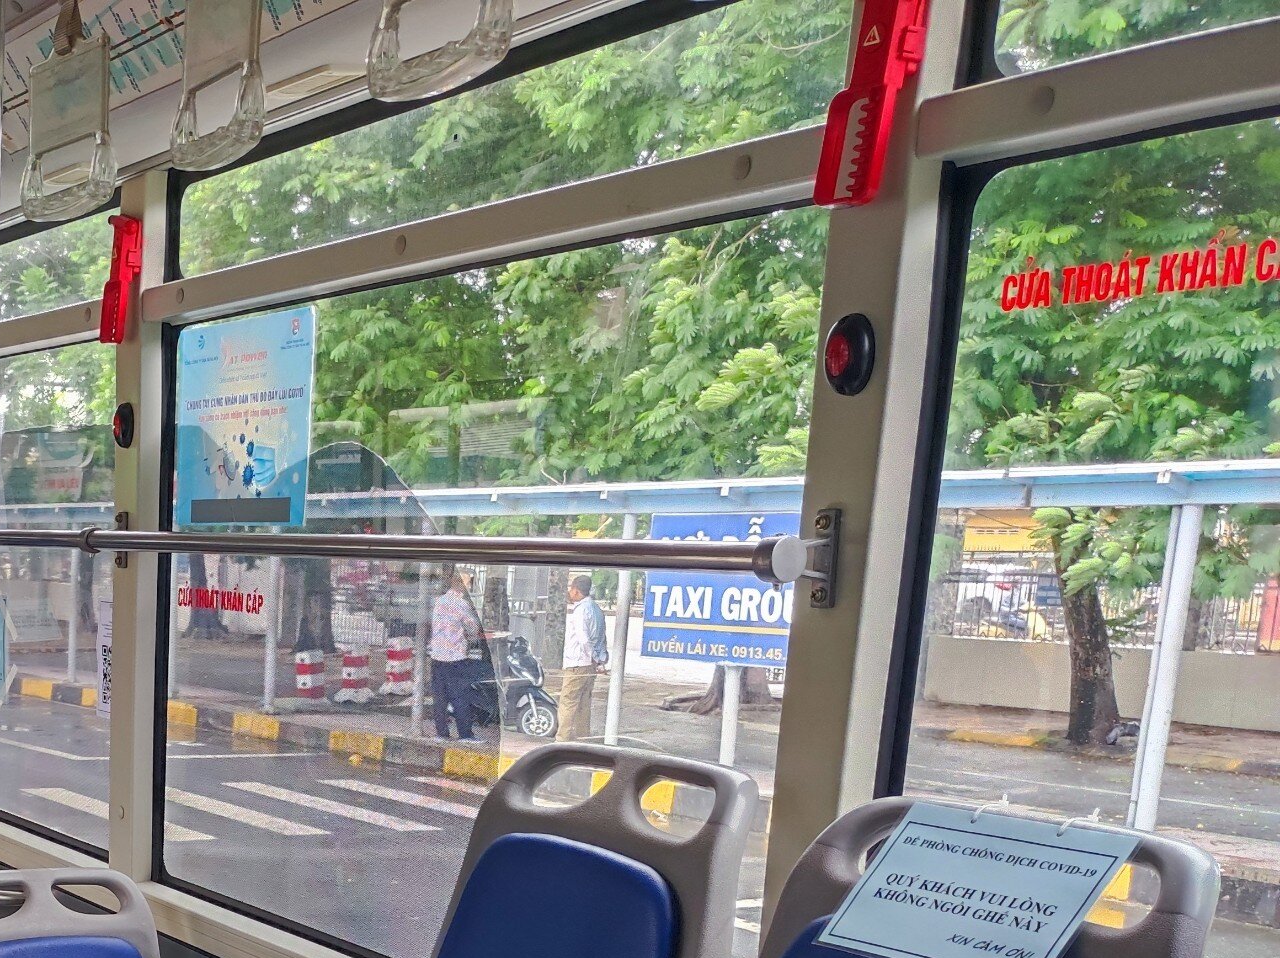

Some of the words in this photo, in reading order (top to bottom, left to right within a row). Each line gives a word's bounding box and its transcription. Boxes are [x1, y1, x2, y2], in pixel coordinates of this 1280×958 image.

[1001, 256, 1051, 312] CỬA
[1062, 249, 1151, 305] THOÁT
[1157, 229, 1247, 293] KHẨN
[650, 585, 713, 620] TAXI
[920, 839, 960, 854] PHÒNG
[1005, 854, 1038, 868] DỊCH
[1039, 860, 1098, 878] COVID-19
[874, 888, 929, 907] KHÔNG
[1008, 915, 1048, 933] NÀY
[886, 873, 920, 887] QUÝ
[919, 879, 978, 900] KHÁCH
[979, 891, 1008, 906] VUI
[1008, 897, 1058, 916] LÒNG
[946, 933, 974, 945] XIN
